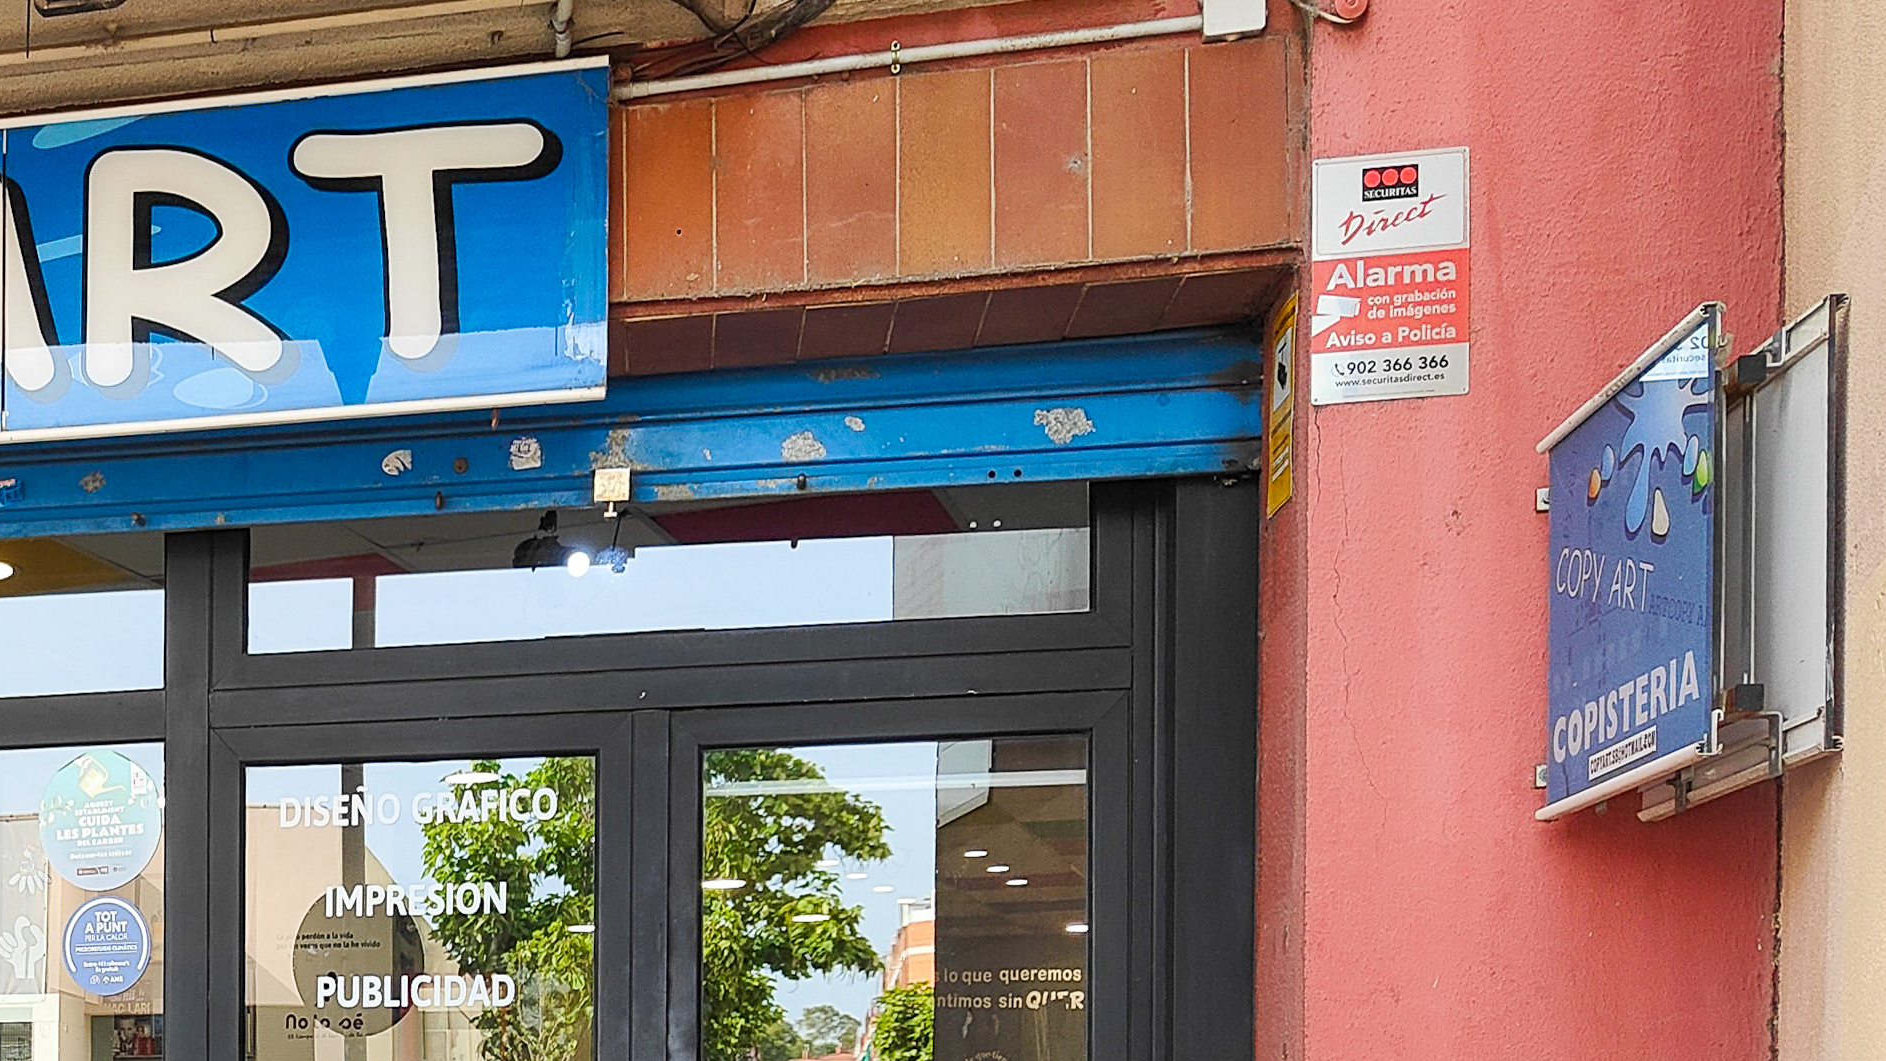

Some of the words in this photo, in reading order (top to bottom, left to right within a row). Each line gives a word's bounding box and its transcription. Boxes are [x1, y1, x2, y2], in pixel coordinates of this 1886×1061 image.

[1364, 186, 1417, 199] SECURITAS
[1338, 193, 1448, 246] Direct
[1326, 260, 1456, 291] Alarma
[1367, 295, 1389, 305] con
[1393, 288, 1456, 305] grabación
[1367, 306, 1385, 319] de
[1389, 304, 1456, 319] imágenes
[1325, 330, 1376, 348] Aviso
[1381, 332, 1392, 343] a
[1398, 323, 1456, 343] Policía
[1347, 360, 1377, 375] 902
[1382, 357, 1413, 372] 366
[1418, 355, 1449, 369] 366
[1335, 372, 1445, 387] www.securitasdirect.es
[1556, 547, 1605, 602] COPY
[1608, 558, 1655, 613] ART
[1553, 650, 1700, 764] COPISTERIA
[74, 806, 125, 815] ESTABLIMENT
[279, 786, 401, 828] DISEÑO
[411, 781, 557, 824] GRÁFICO
[78, 814, 121, 827] CUIDA
[56, 829, 79, 840] LES
[82, 823, 144, 838] PLANTES
[325, 876, 507, 917] IMPRESIÓN
[95, 911, 117, 922] TOT
[85, 923, 94, 934] A
[97, 921, 127, 933] PUNT
[319, 942, 332, 950] que
[360, 940, 380, 948] vivido
[944, 968, 958, 982] lo
[962, 970, 992, 986] que
[999, 968, 1082, 985] queremos
[316, 974, 515, 1009] PUBLICIDAD
[937, 993, 992, 1009] ntimos
[998, 993, 1023, 1009] sin
[285, 1013, 309, 1029] No
